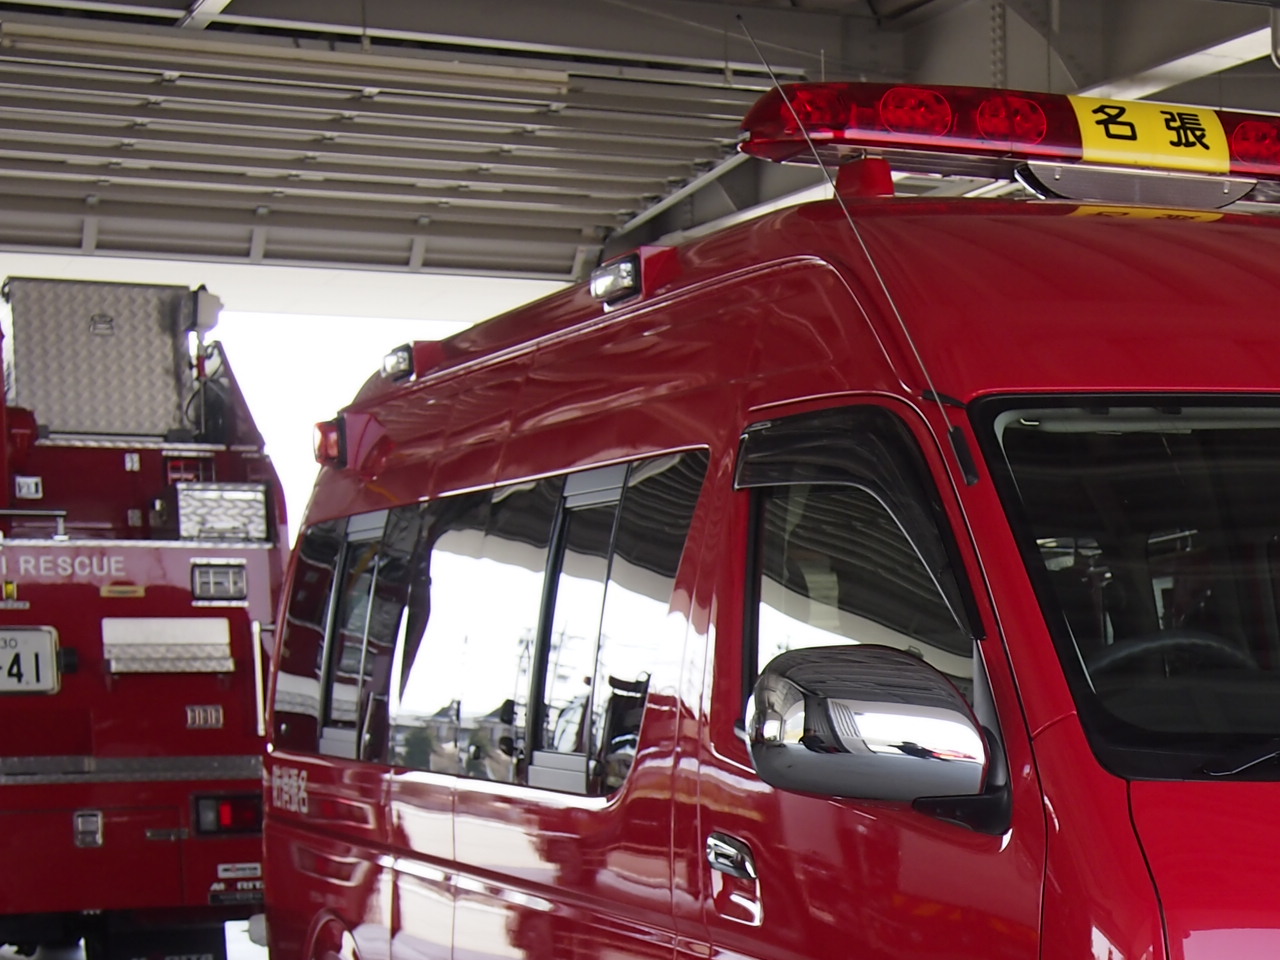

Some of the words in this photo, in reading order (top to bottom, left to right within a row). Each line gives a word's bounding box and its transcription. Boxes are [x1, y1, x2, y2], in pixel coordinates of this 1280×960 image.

[1091, 104, 1210, 150] 名張
[19, 556, 126, 576] RESCUE
[209, 881, 264, 892] MORIT
